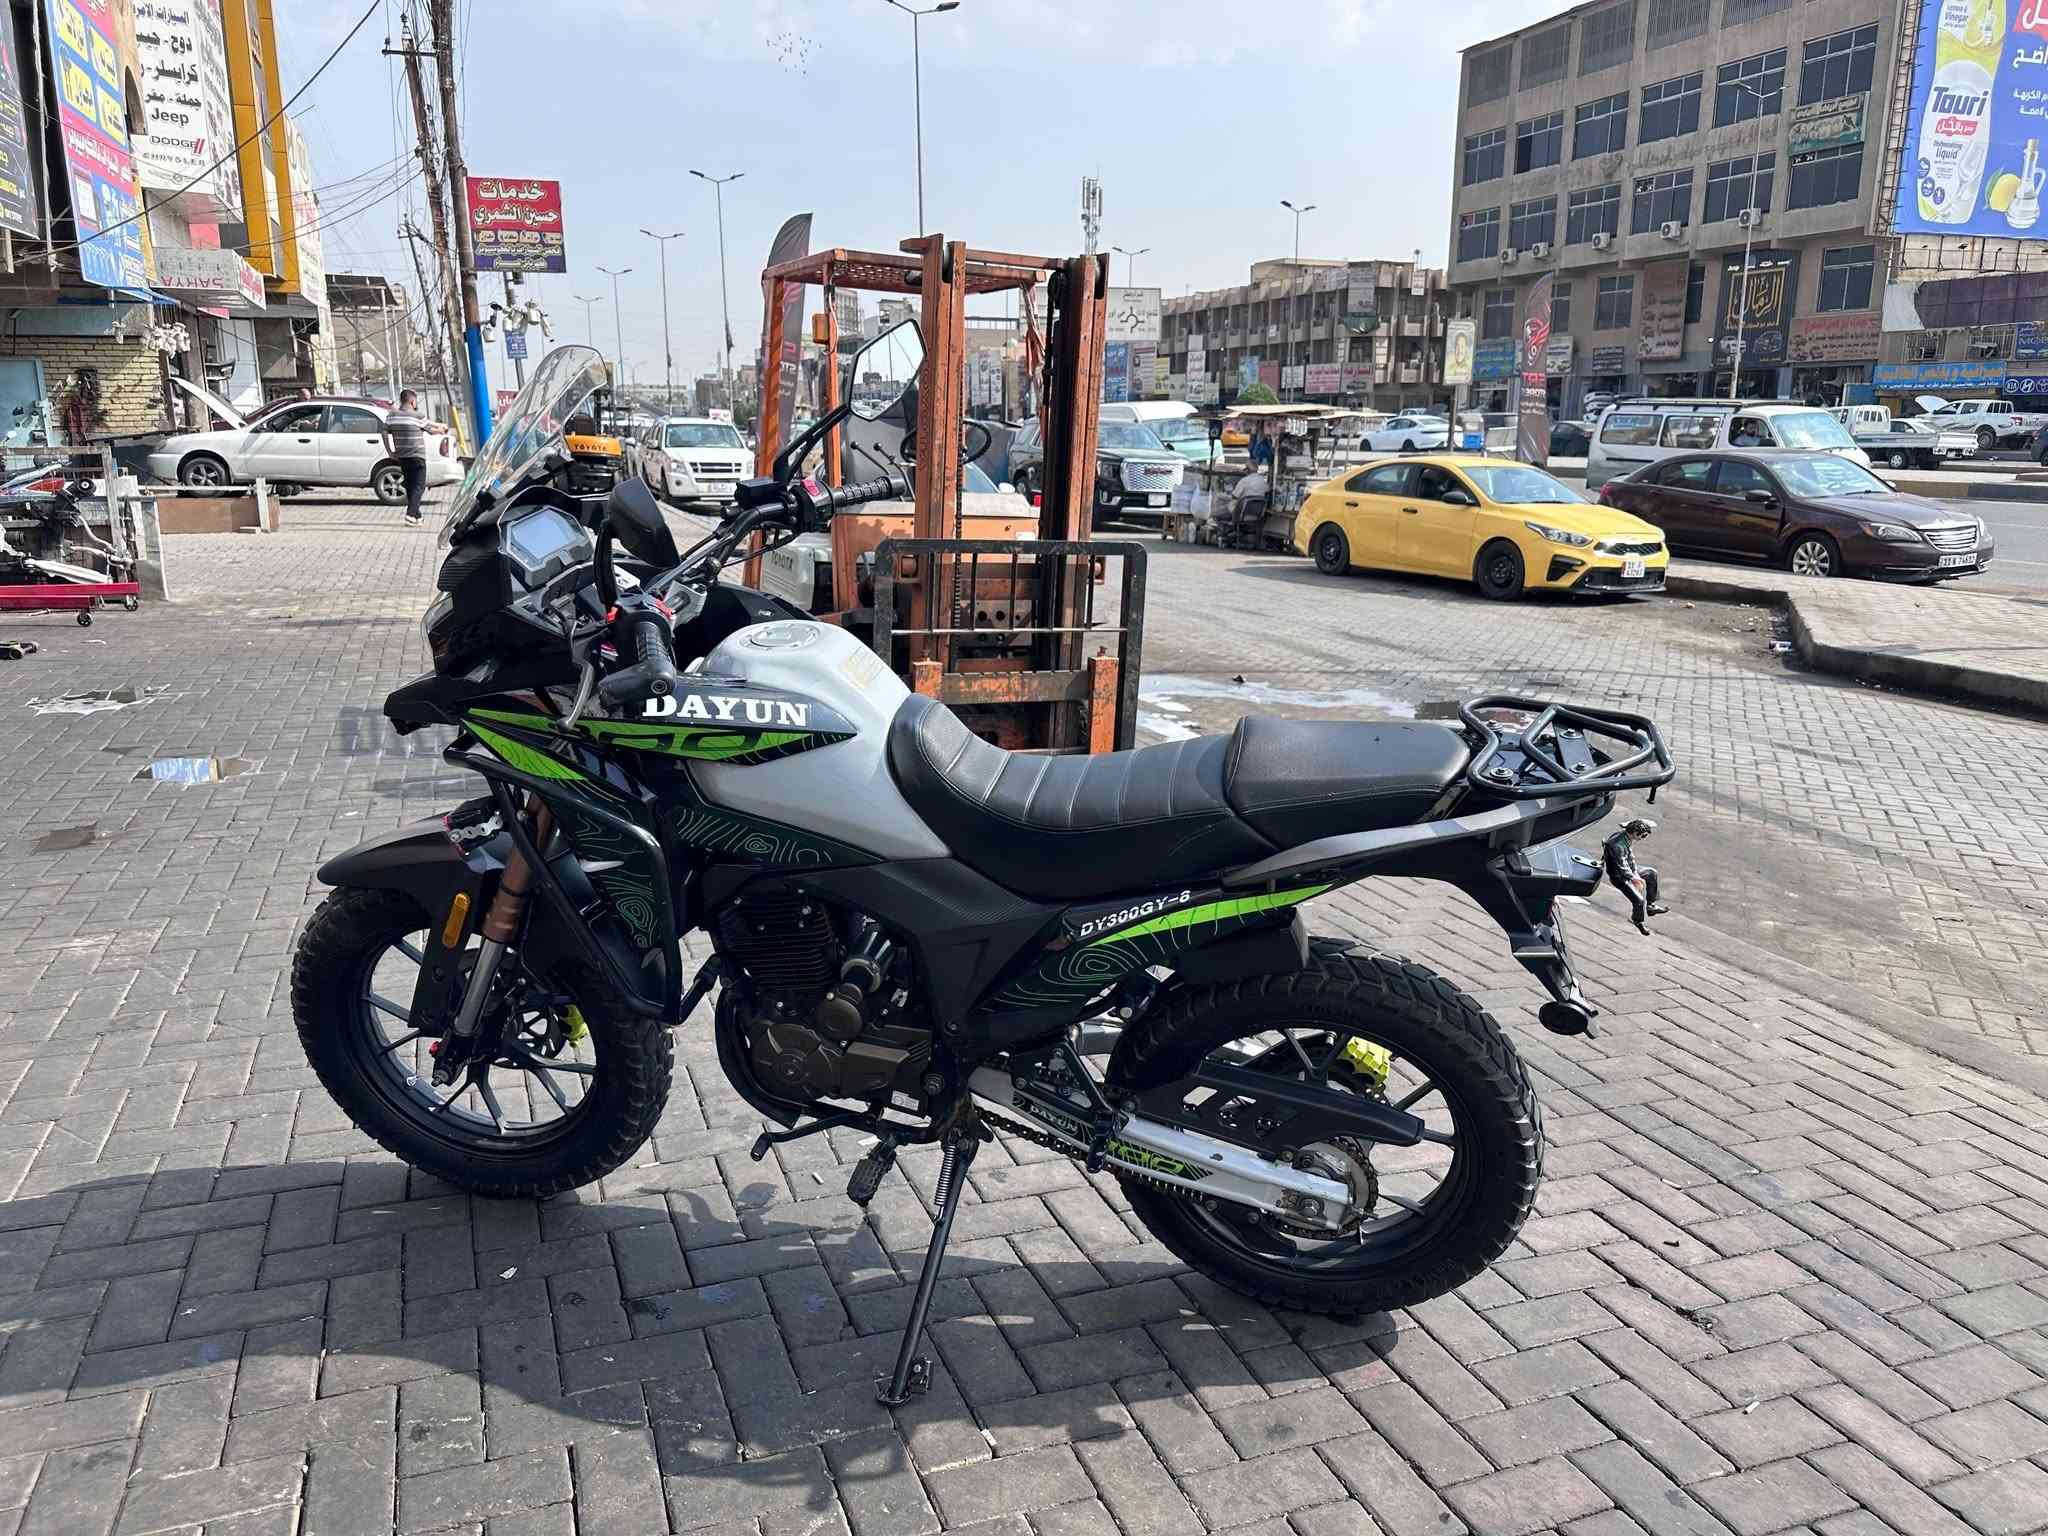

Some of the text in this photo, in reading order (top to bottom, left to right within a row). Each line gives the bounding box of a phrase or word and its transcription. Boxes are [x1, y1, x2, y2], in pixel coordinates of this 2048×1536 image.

[1931, 86, 1990, 117] Touri
[151, 107, 190, 126] Jeep
[151, 135, 196, 148] DODGE
[142, 152, 206, 167] CHRYSLER
[479, 180, 545, 199] خدمات
[475, 203, 559, 226] حسين الشمري
[642, 694, 808, 727] DAYUN
